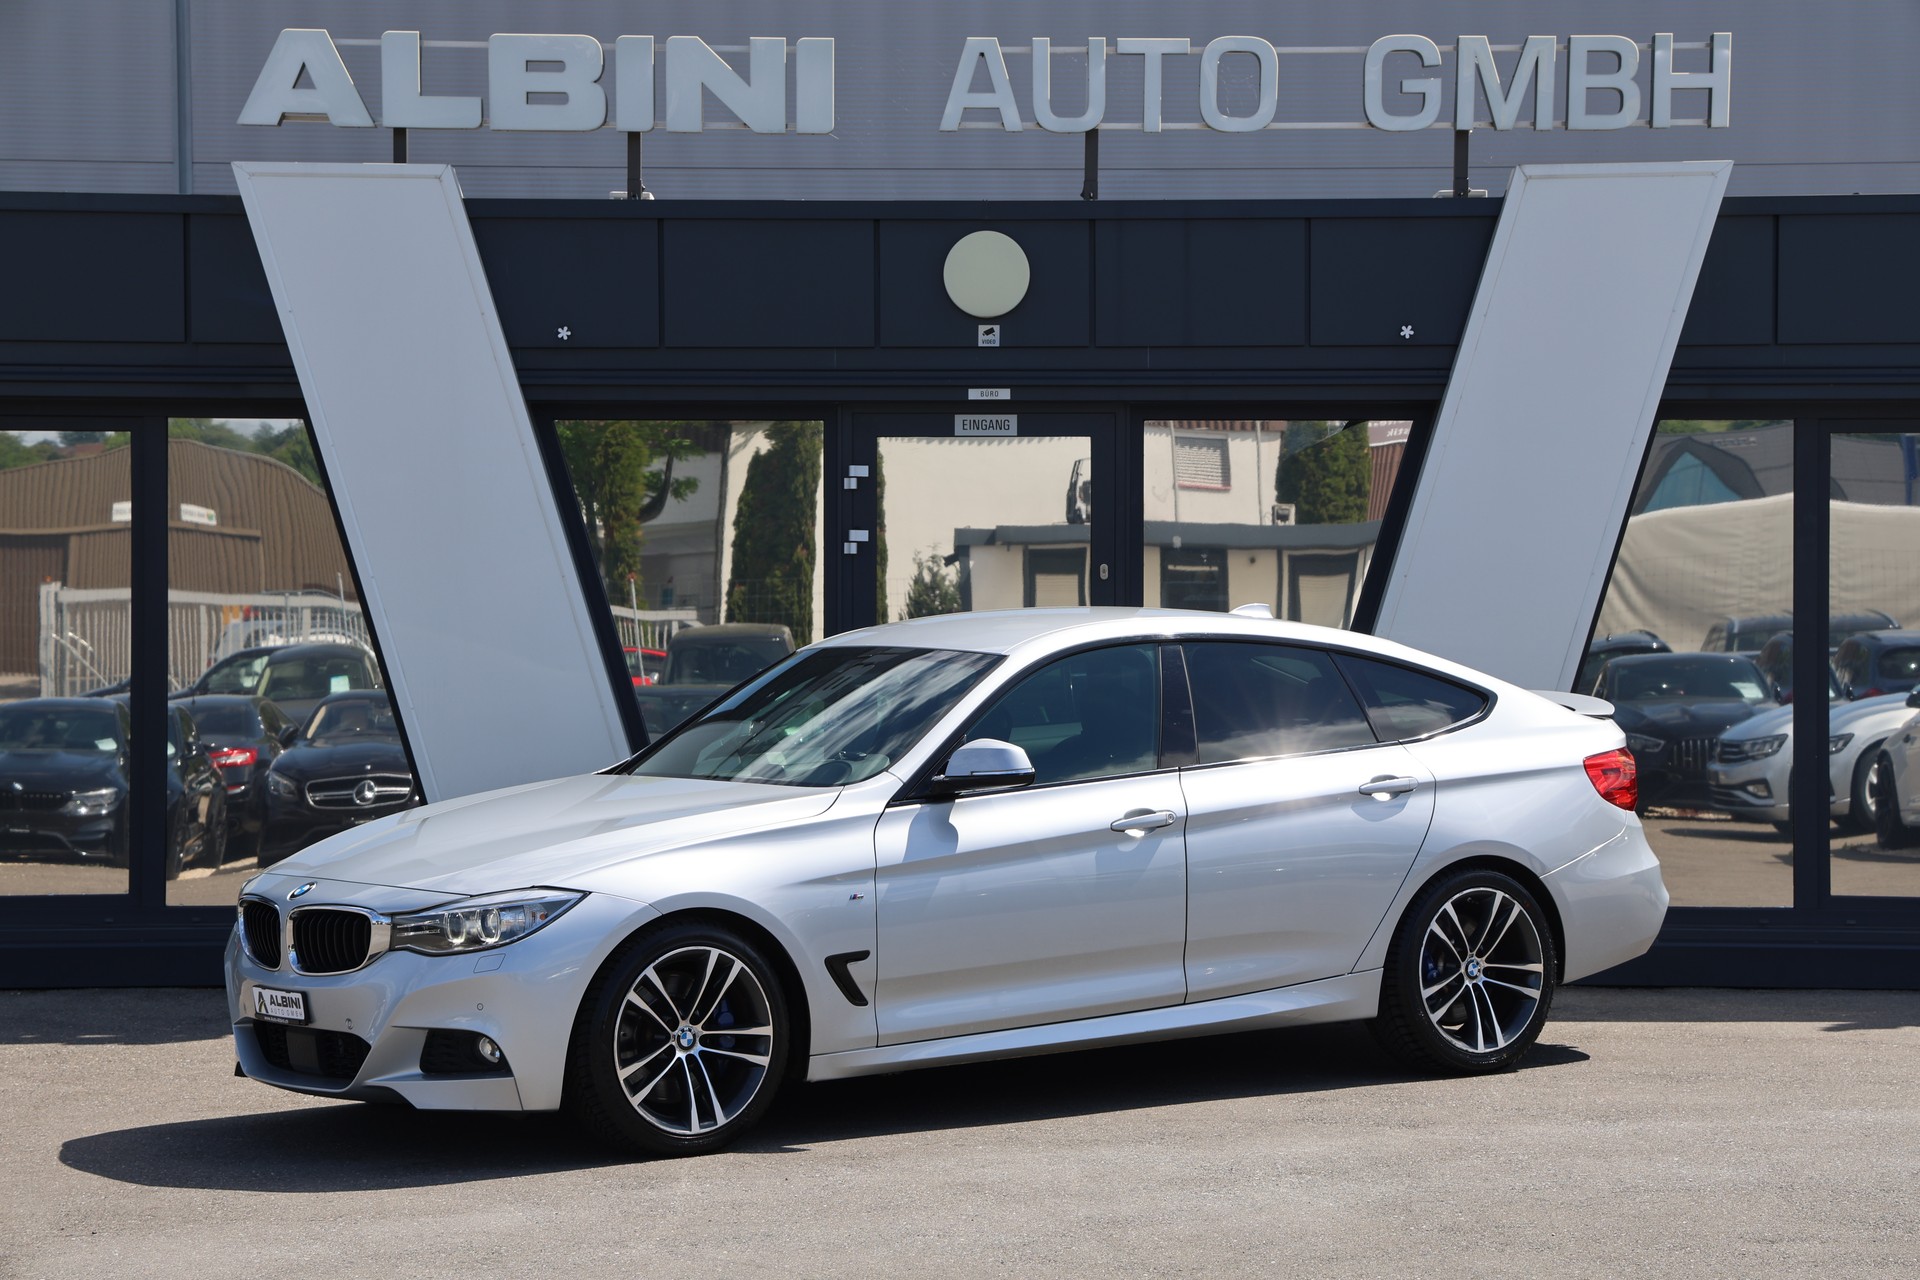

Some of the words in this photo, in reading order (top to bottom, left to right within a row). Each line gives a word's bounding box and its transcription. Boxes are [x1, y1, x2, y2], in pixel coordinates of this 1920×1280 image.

[237, 28, 835, 134] ALBINI
[939, 35, 1279, 133] AUTO
[1364, 32, 1732, 131] GMBH
[962, 419, 1010, 430] EINGANG
[269, 994, 301, 1009] ALBINI
